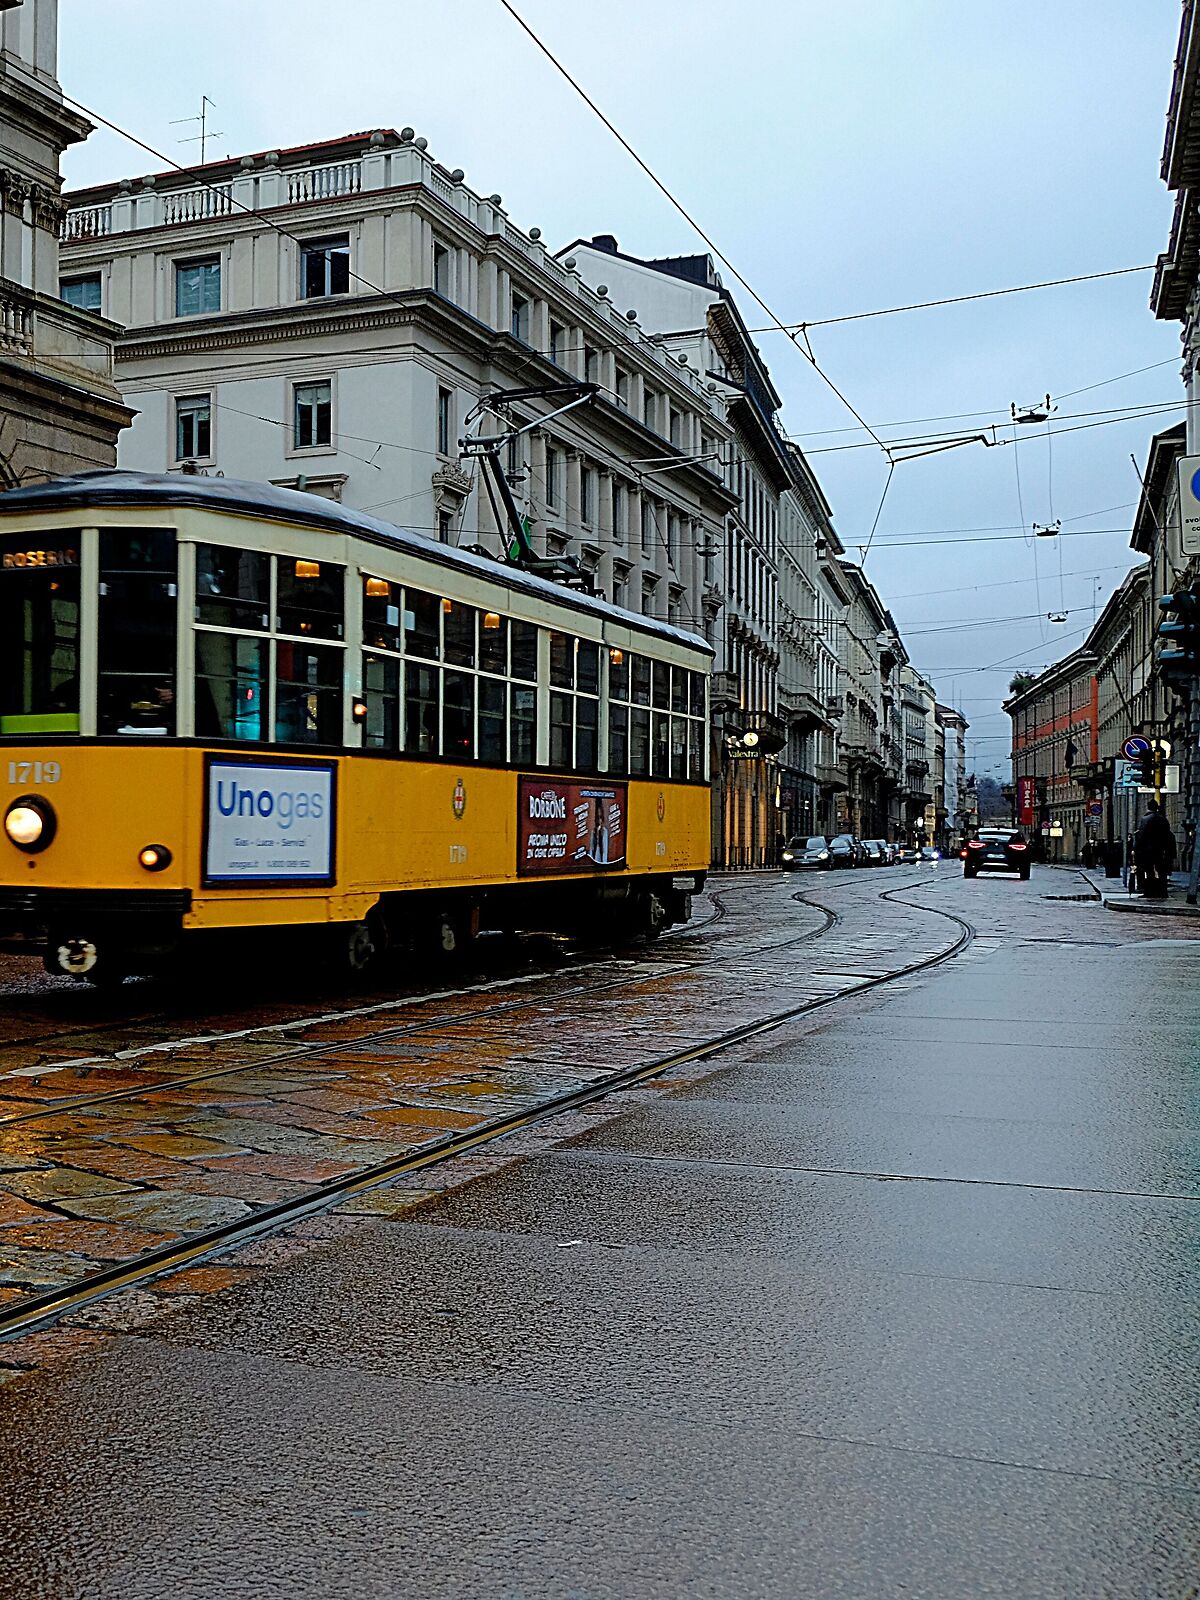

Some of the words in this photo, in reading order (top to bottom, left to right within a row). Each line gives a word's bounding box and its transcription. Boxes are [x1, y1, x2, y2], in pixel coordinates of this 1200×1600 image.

[8, 761, 61, 784] 1719
[217, 781, 323, 829] Unogas
[529, 795, 566, 818] BORBONE
